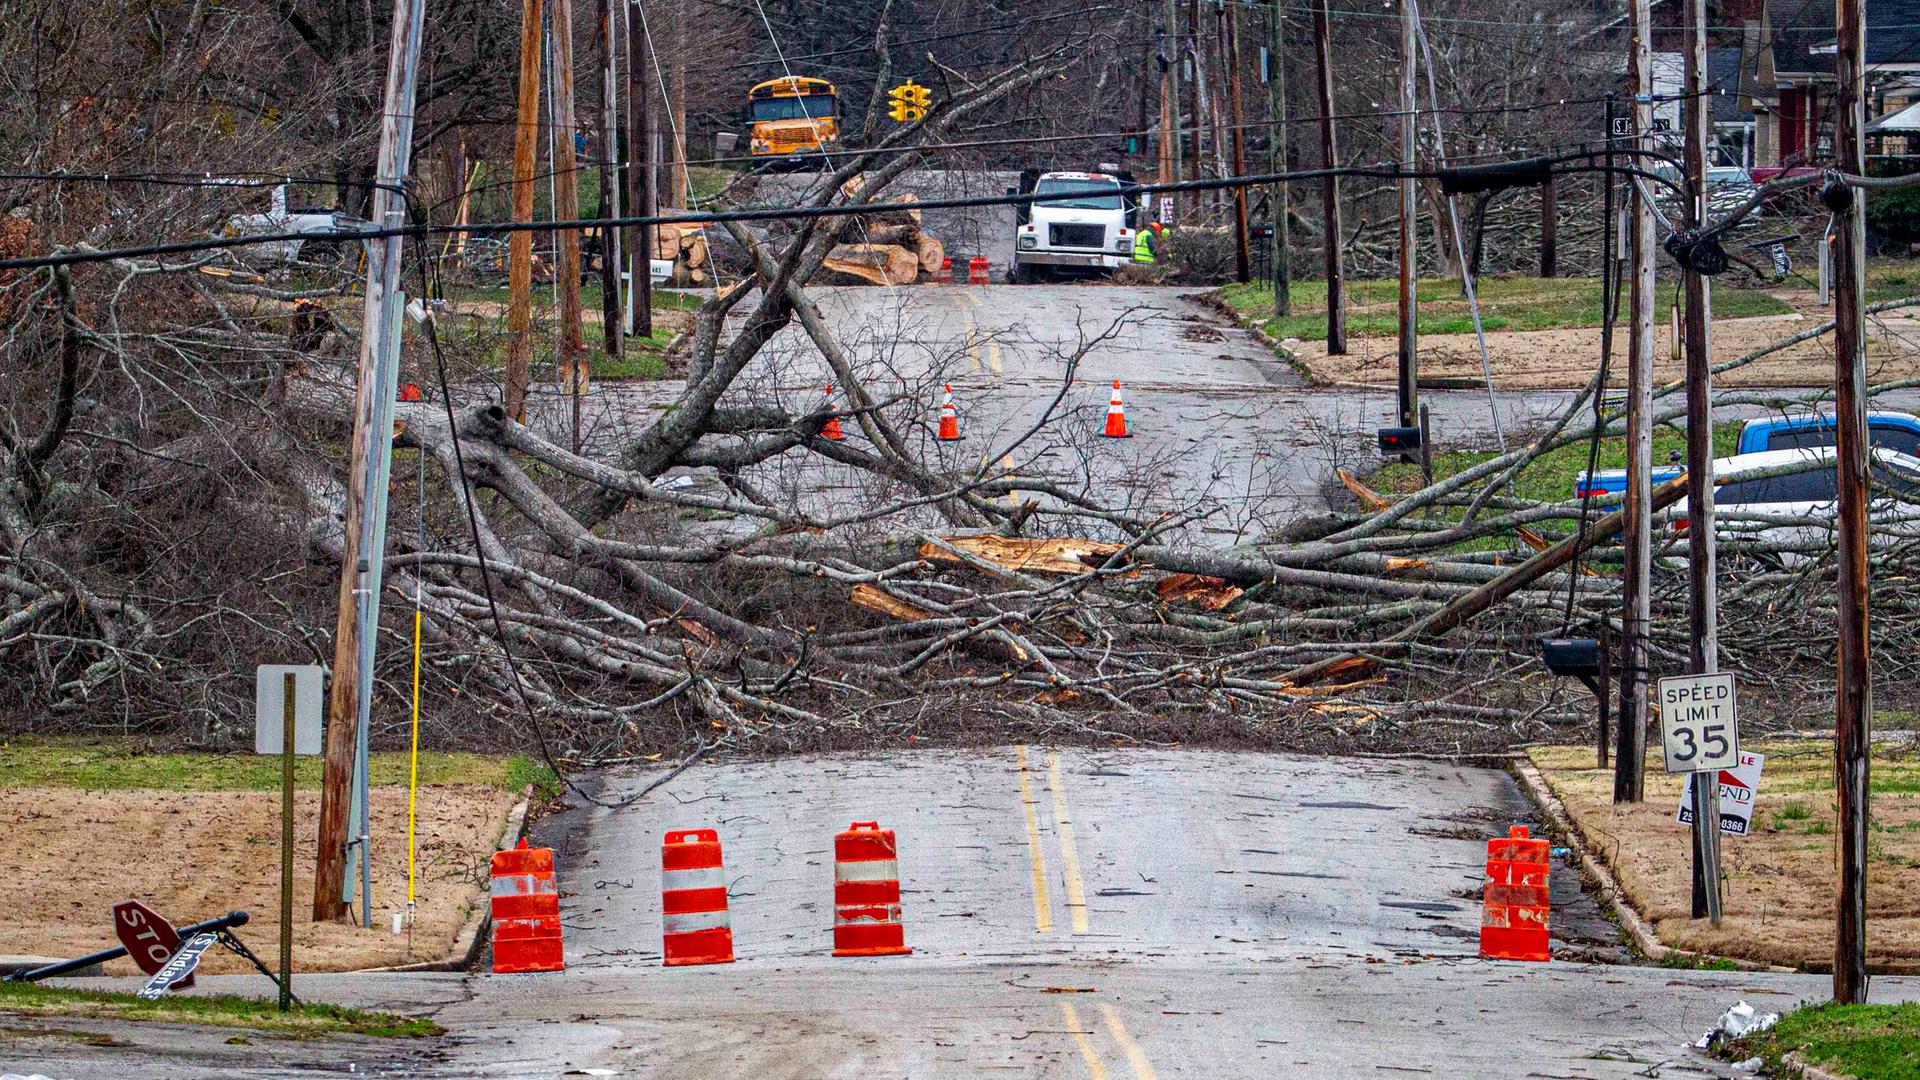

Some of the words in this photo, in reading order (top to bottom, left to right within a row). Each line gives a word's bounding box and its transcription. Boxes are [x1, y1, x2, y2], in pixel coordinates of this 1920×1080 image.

[1667, 685, 1729, 703] SPEED
[1675, 705, 1721, 722] LIMIT
[1672, 725, 1729, 761] 35
[1740, 755, 1755, 766] LE
[1718, 785, 1751, 801] END
[1720, 818, 1743, 832] 0366
[121, 908, 172, 964] STO
[194, 936, 213, 946] S
[154, 949, 201, 985] Indian
